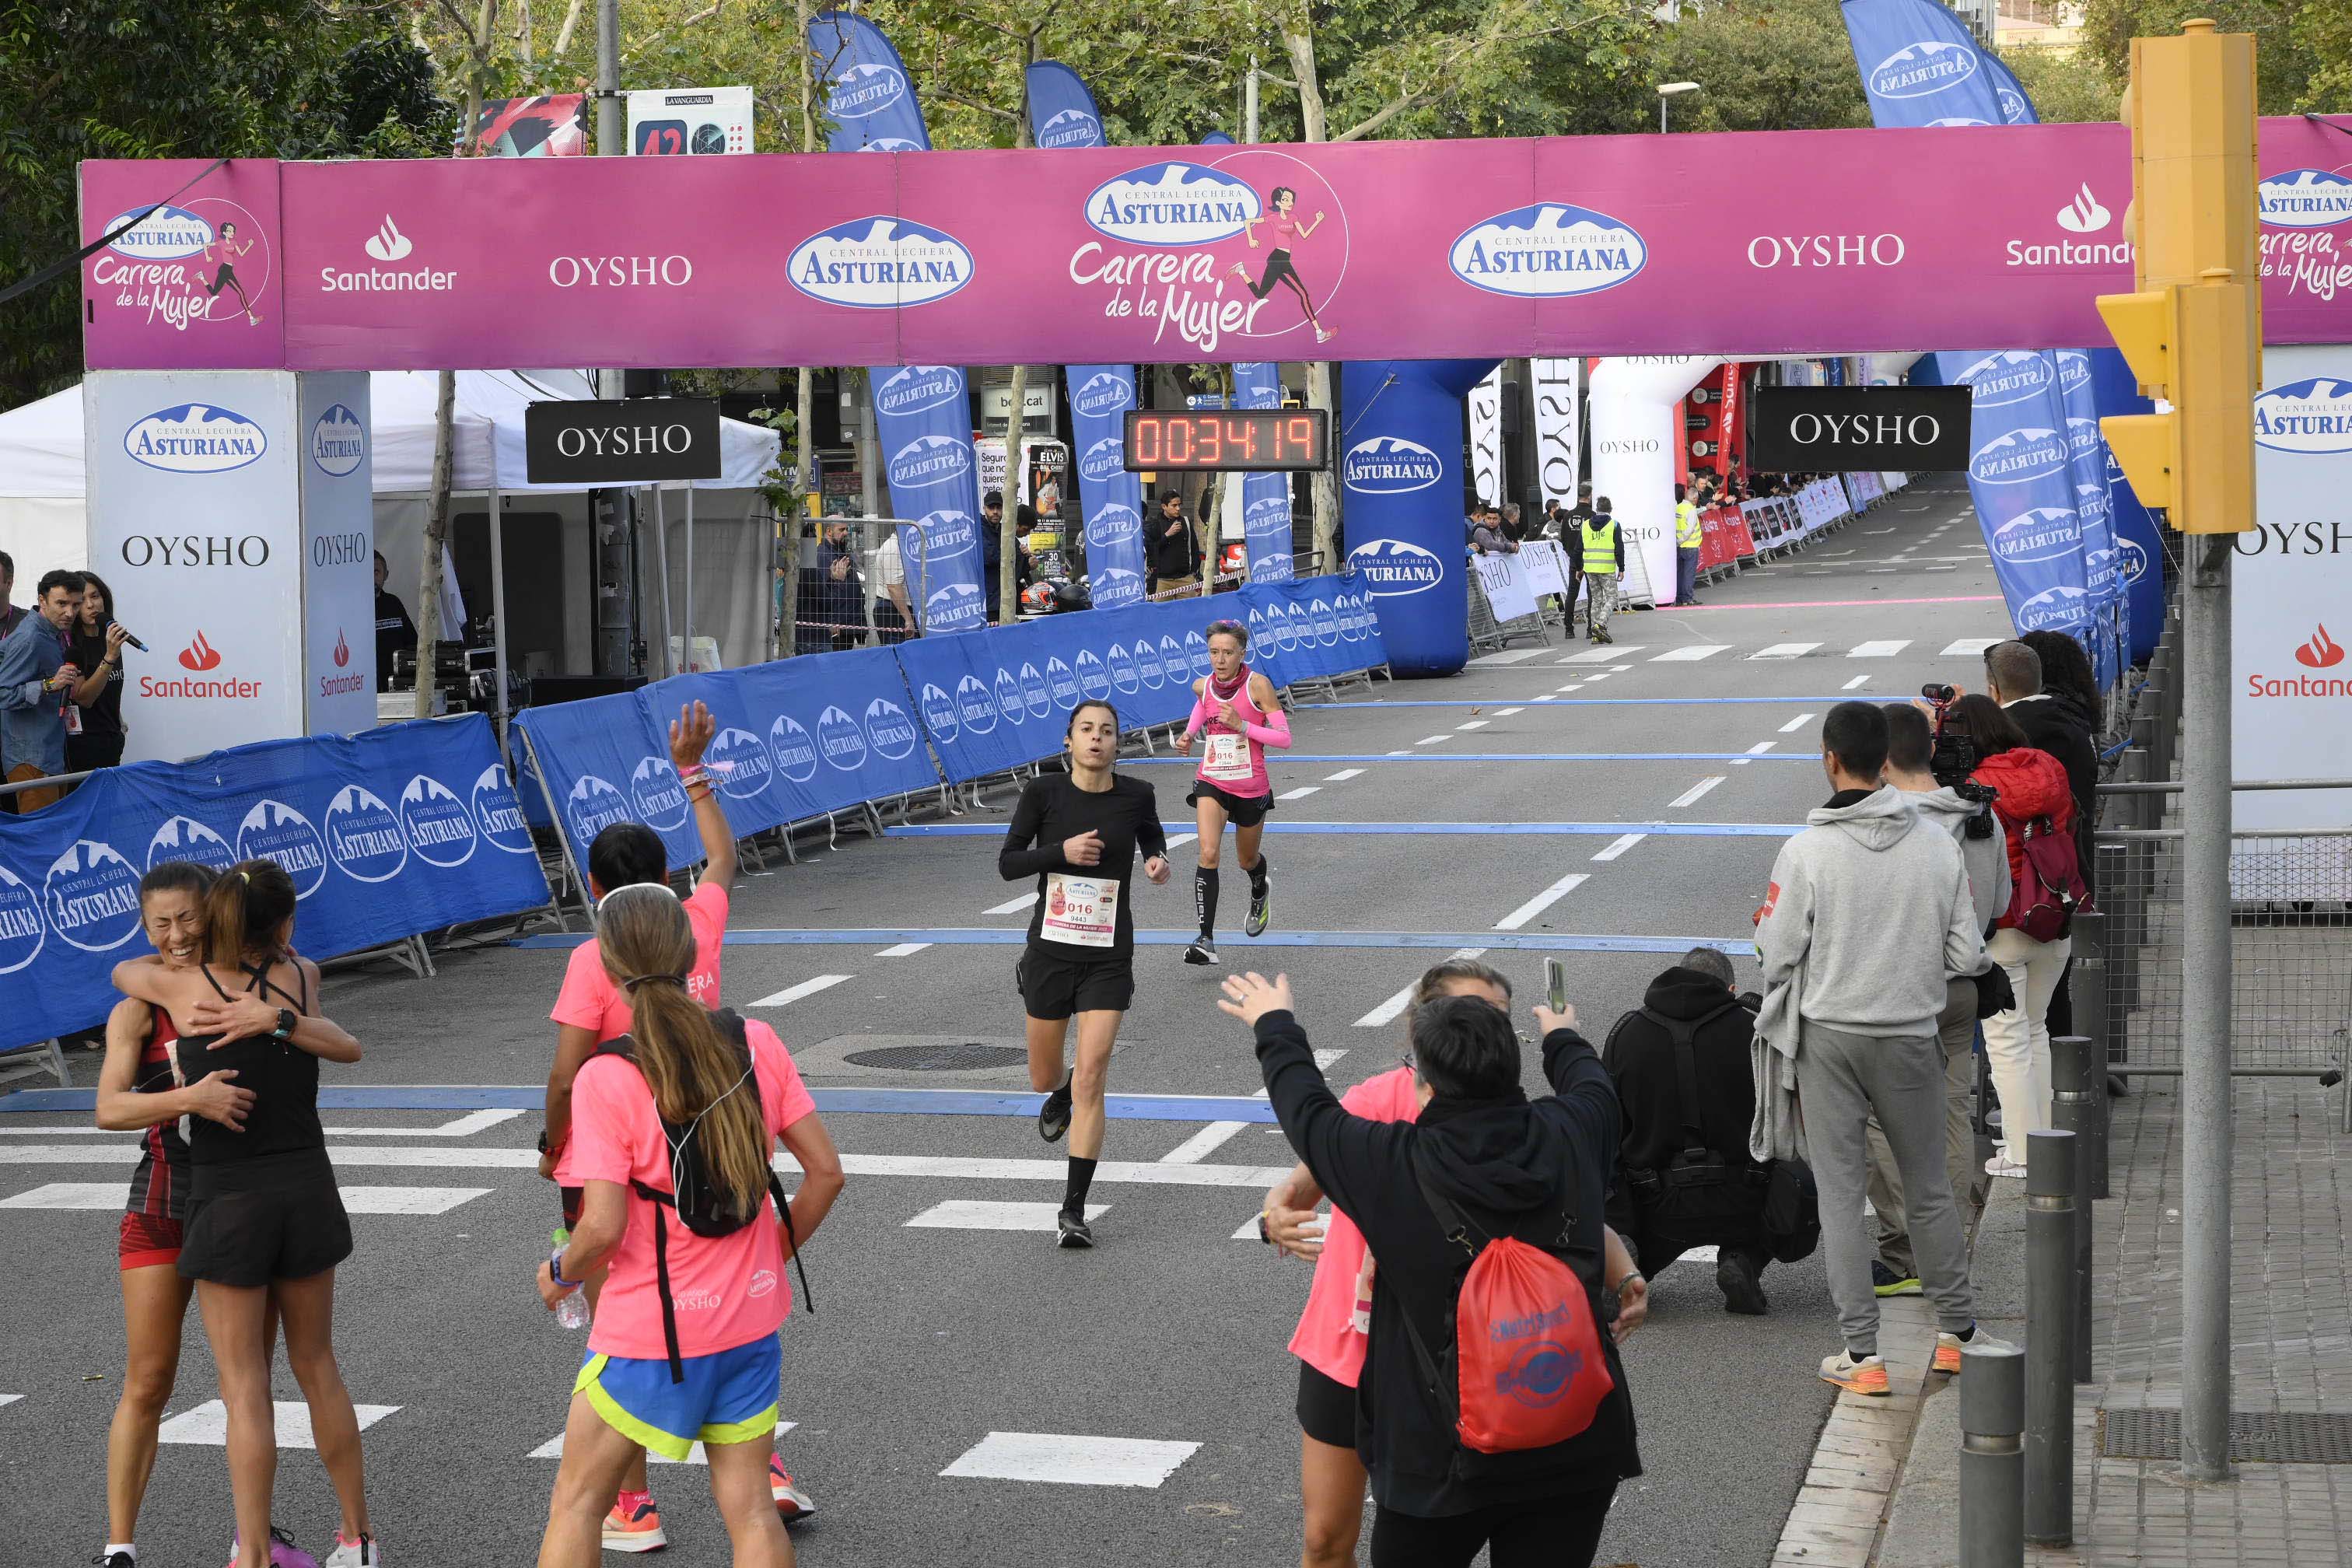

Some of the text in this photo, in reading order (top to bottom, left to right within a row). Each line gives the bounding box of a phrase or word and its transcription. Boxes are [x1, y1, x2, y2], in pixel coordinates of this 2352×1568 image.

[1098, 194, 1245, 225] ASTURIANA
[1125, 189, 1241, 199] CENTRAL LECHERA
[830, 247, 952, 258] CENTRAL LECHERA
[1494, 234, 1626, 246] CENTRAL LECHERA
[1748, 233, 1905, 268] OYSHO
[2007, 238, 2133, 266] Santand
[2259, 232, 2333, 254] arrera
[93, 256, 184, 285] Carrera
[550, 255, 691, 288] OYSHO
[801, 250, 959, 285] ASTURIANA
[1069, 241, 1215, 285] Carrera
[1465, 239, 1632, 274] ASTURIANA
[322, 266, 457, 292] Santander
[2278, 255, 2291, 276] la
[2288, 250, 2352, 300] Muje
[117, 283, 220, 331] de la Mujer
[1105, 279, 1269, 352] de la Mujer
[135, 430, 257, 456] ASTURIANA
[316, 432, 361, 459] ASTURIANA
[557, 424, 691, 457] OYSHO
[1137, 418, 1312, 462] 00:34:19
[1790, 414, 1940, 446] OYSHO
[1041, 452, 1064, 462] ELVIS
[1600, 439, 1659, 454] OYSHO
[982, 465, 995, 474] que
[1347, 460, 1434, 481] ASTURIANA
[122, 535, 269, 567] OYSHO
[314, 532, 366, 567] OYSHO
[2233, 522, 2352, 555] OYSH
[1048, 553, 1058, 562] 30
[140, 677, 262, 698] Santander
[320, 672, 364, 698] Santander
[333, 824, 404, 863] ASTURIANA
[407, 813, 473, 848] ASTURIANA
[1068, 903, 1093, 914] 016
[1196, 877, 1206, 924] kalenji
